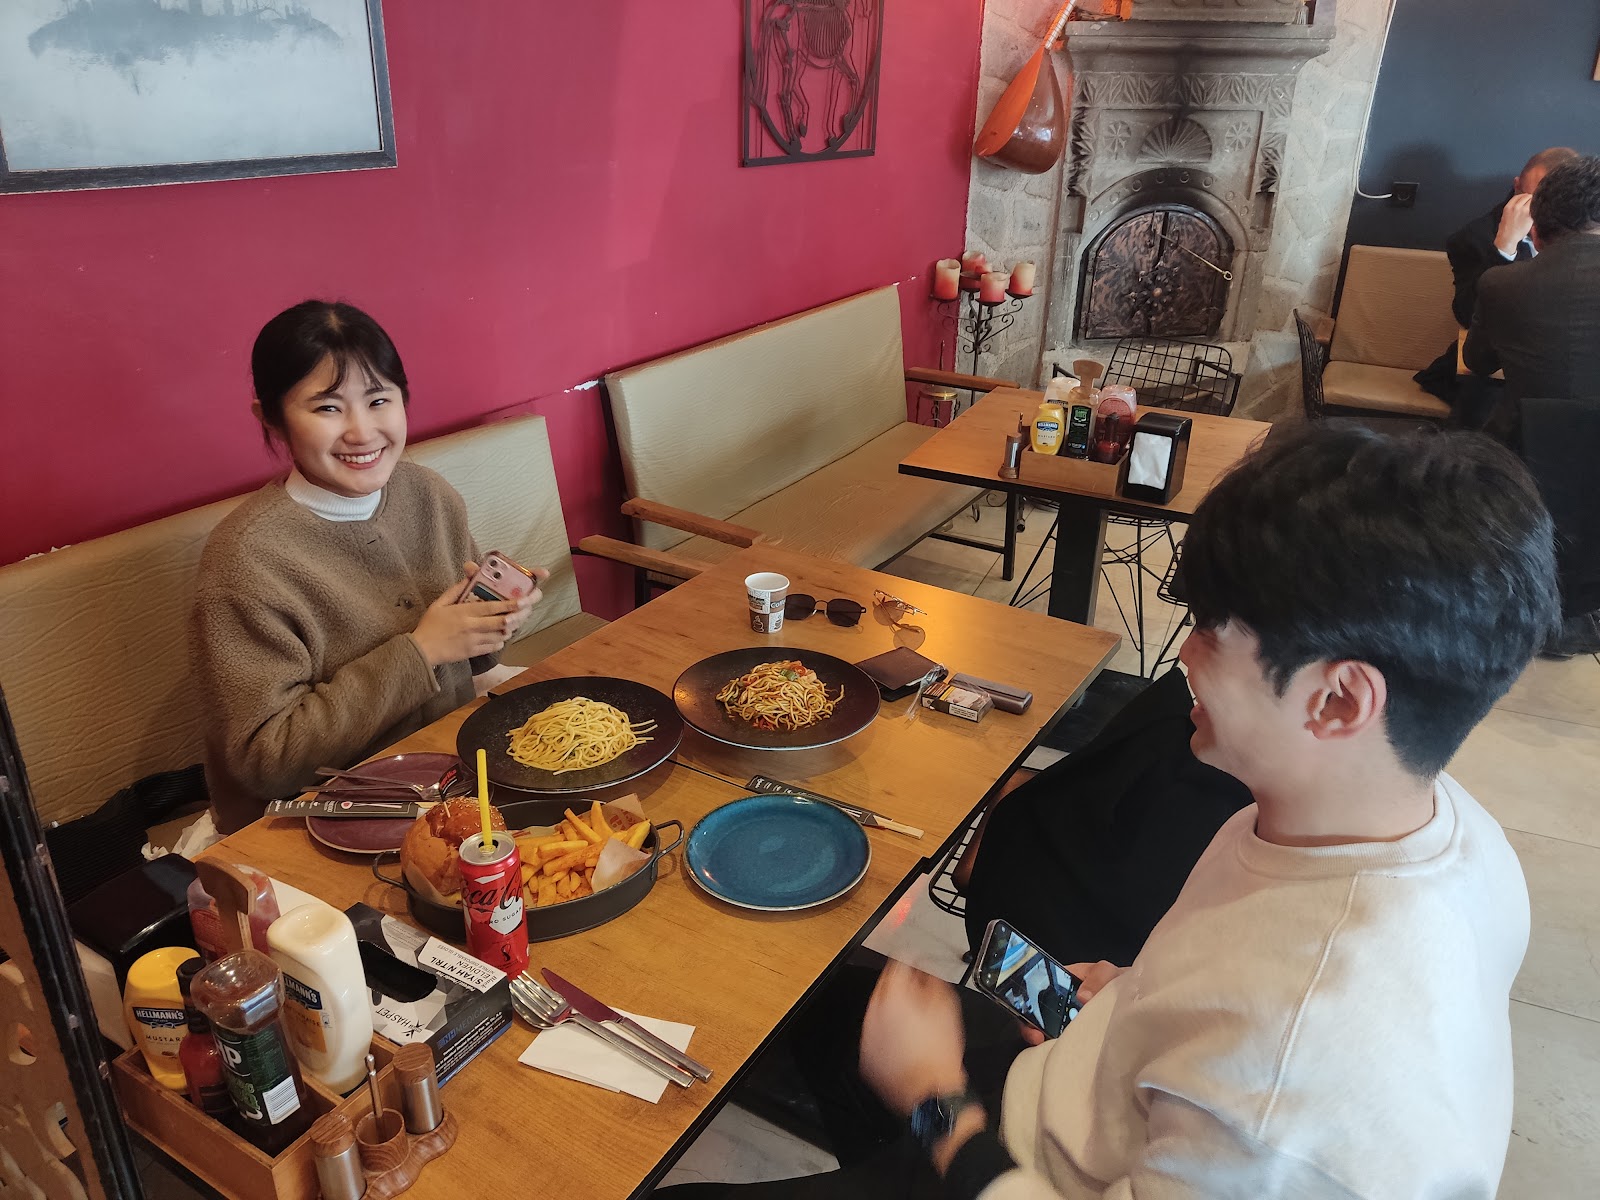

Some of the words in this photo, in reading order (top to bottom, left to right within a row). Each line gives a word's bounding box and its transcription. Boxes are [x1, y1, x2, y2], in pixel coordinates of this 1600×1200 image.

[502, 906, 522, 922] SUGAR
[135, 1009, 185, 1020] HELLMANN'S
[375, 1007, 411, 1027] HASPET
